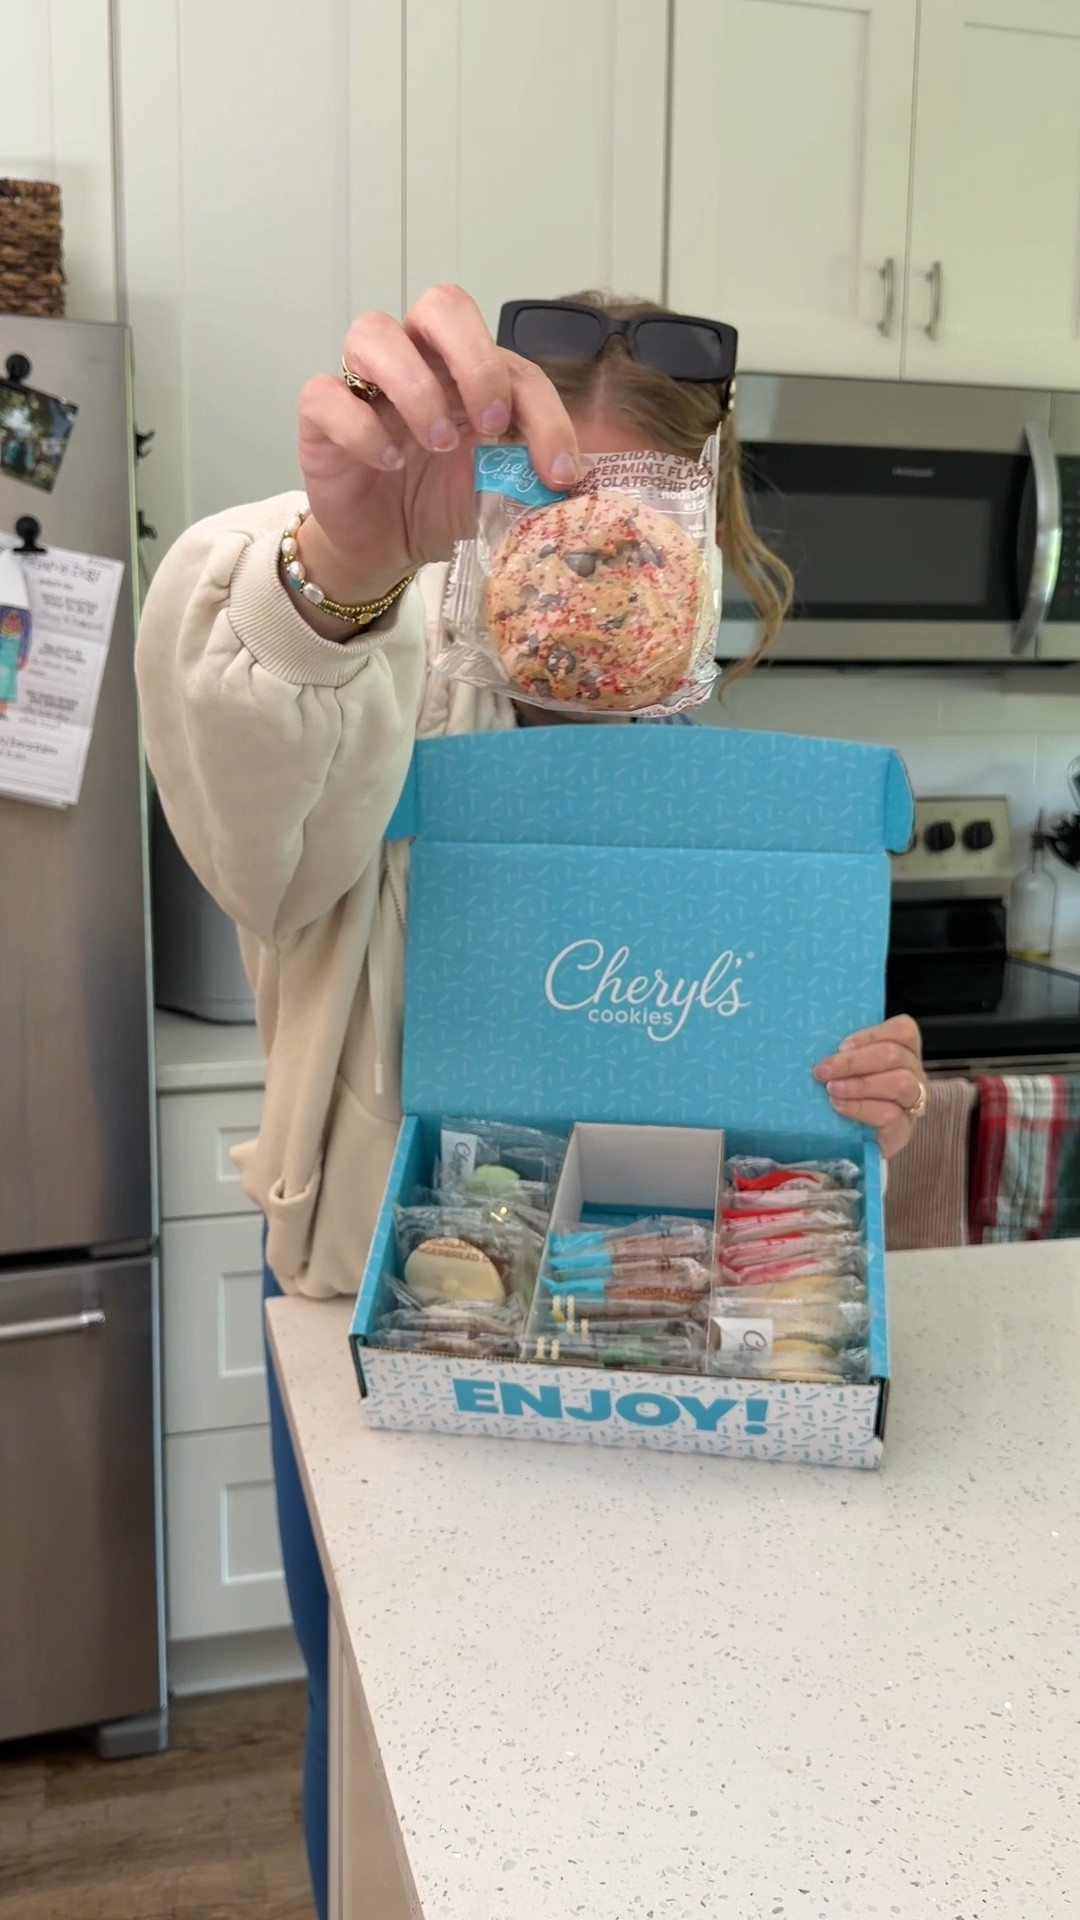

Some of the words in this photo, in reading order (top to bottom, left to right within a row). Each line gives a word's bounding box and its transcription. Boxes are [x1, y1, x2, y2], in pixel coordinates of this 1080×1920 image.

[597, 450, 668, 466] HOLIDAY
[545, 939, 752, 1042] Cheryl's
[588, 1007, 674, 1026] cookies
[452, 1378, 769, 1436] ENJOY!
